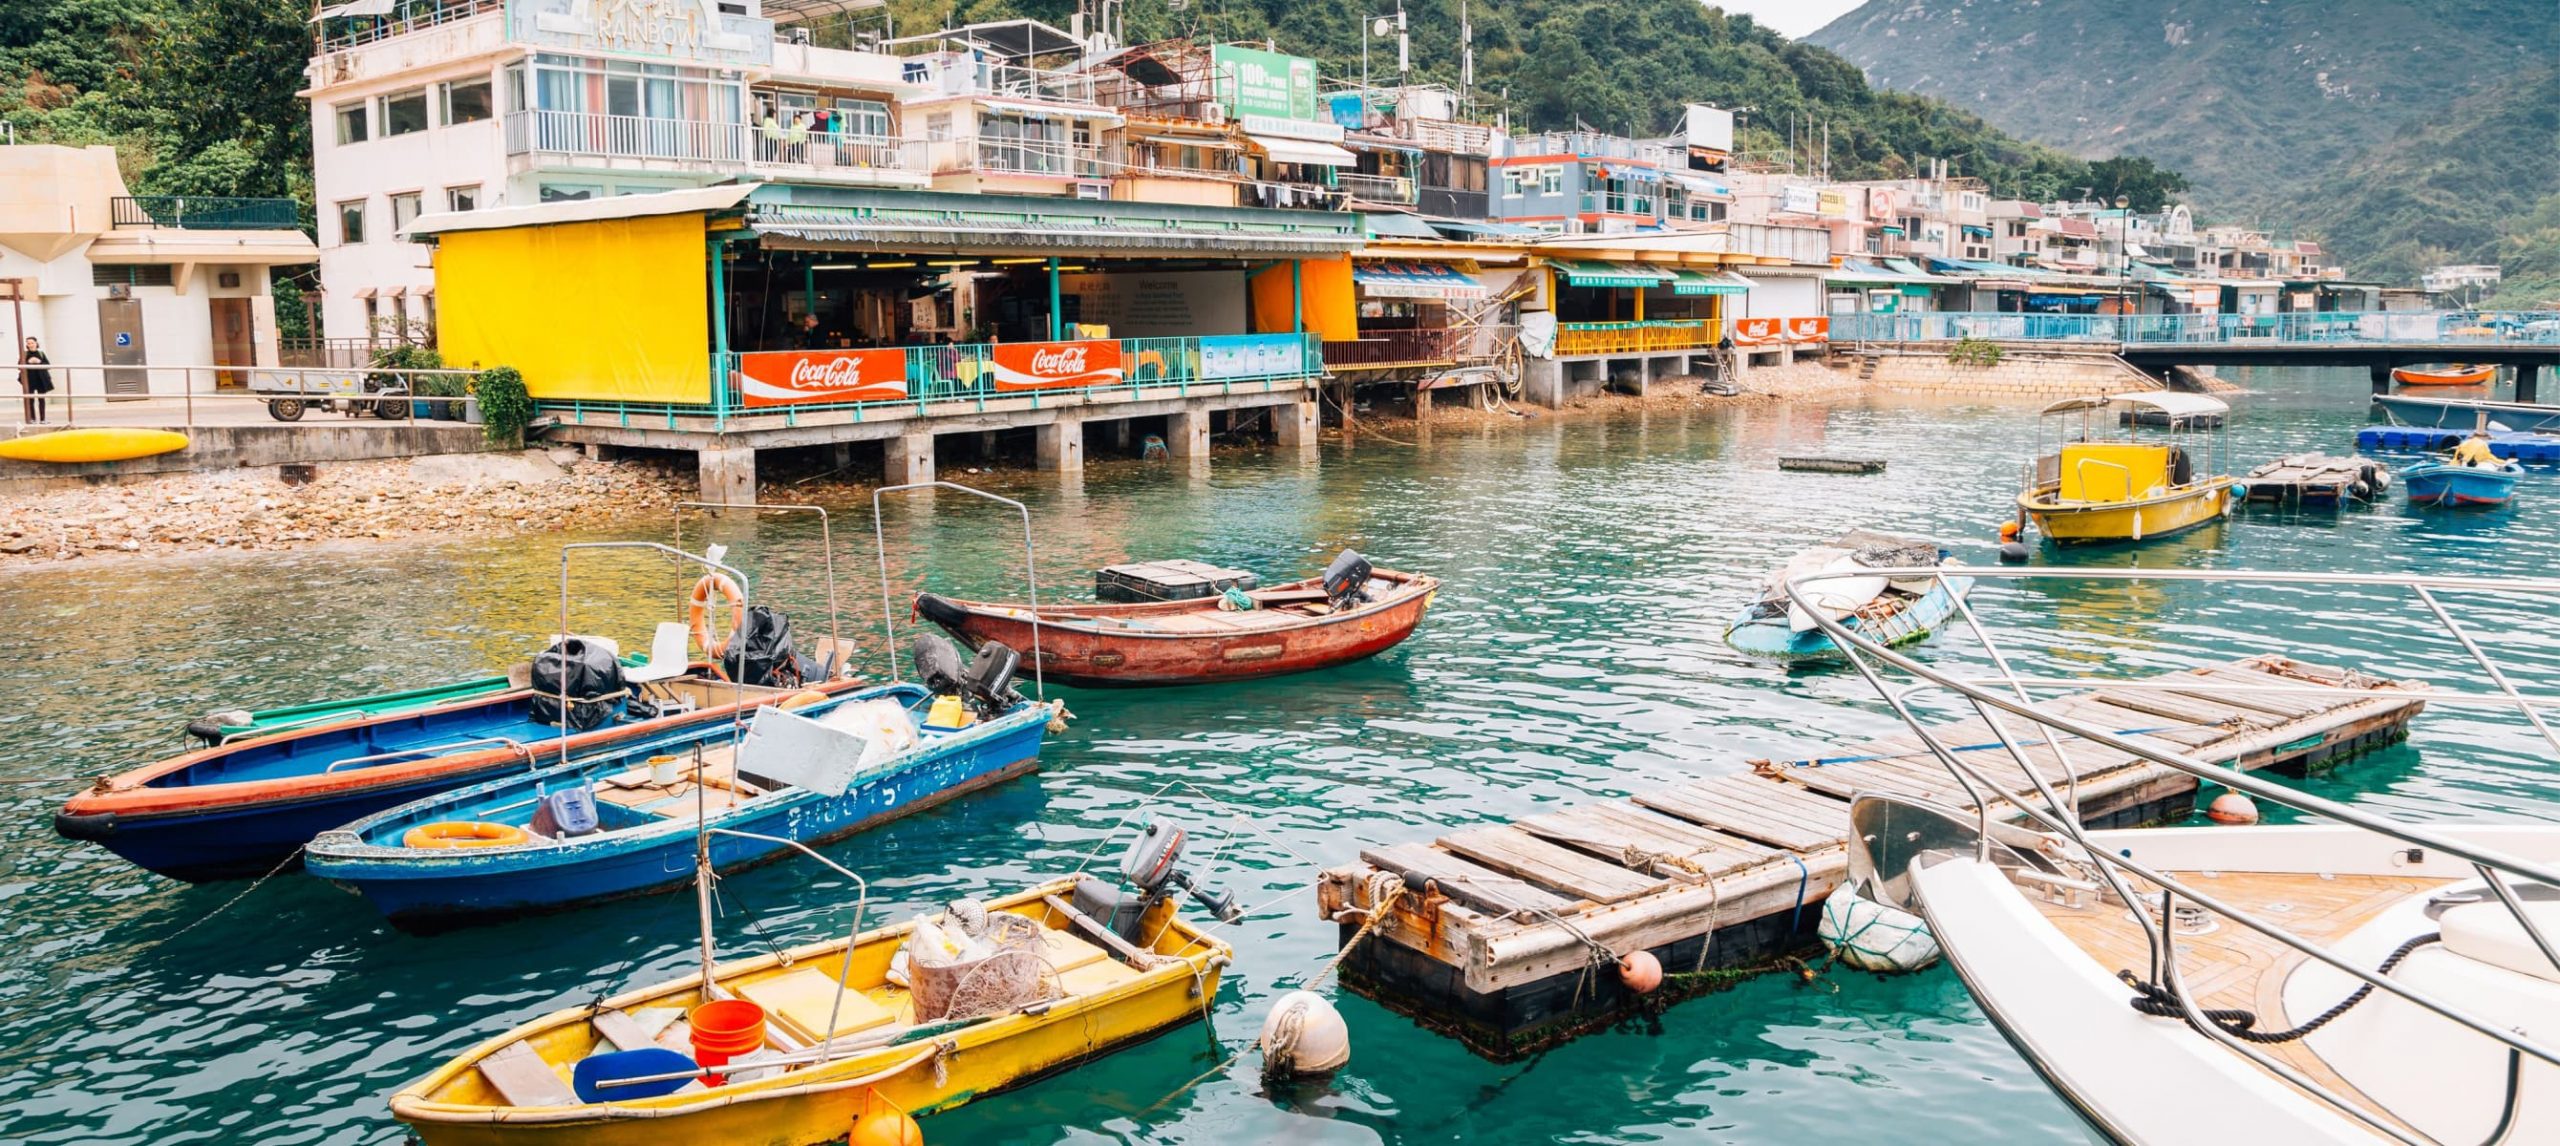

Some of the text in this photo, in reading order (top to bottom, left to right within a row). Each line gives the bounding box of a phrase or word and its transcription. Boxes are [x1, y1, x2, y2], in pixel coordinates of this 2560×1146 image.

[598, 17, 696, 48] RAINBOW
[1138, 280, 1178, 290] Welcome
[791, 356, 863, 388] Coca-Cola
[1031, 347, 1088, 376] Coca-Cola
